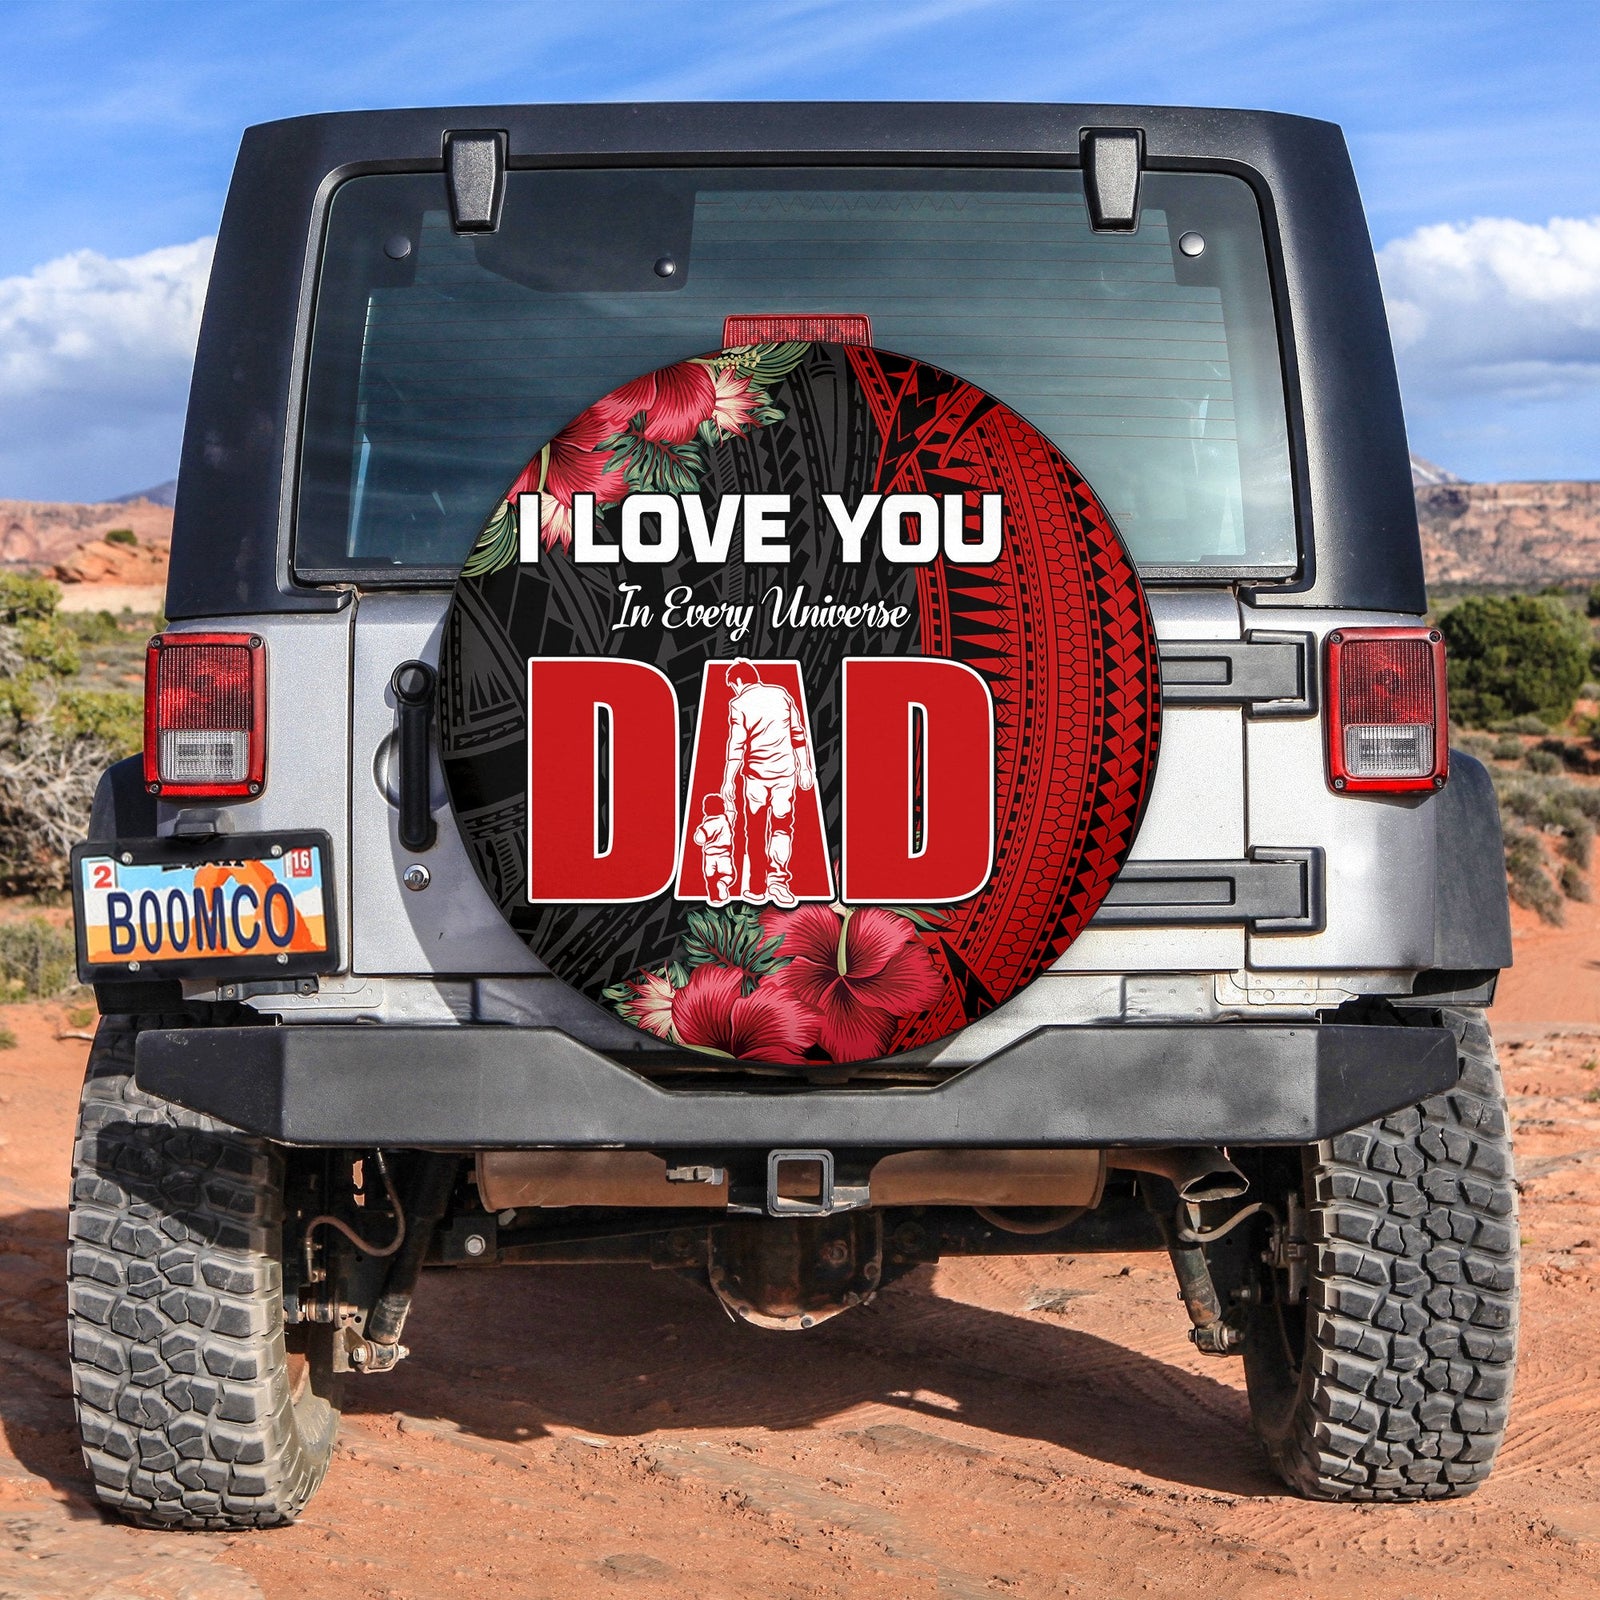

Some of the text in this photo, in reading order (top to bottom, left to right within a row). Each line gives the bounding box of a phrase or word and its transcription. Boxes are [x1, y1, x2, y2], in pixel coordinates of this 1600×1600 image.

[519, 494, 1002, 563] I LOVE YOU
[611, 582, 911, 641] In Every Universe
[527, 656, 995, 905] DAD
[94, 865, 112, 889] 2
[292, 850, 310, 869] 16
